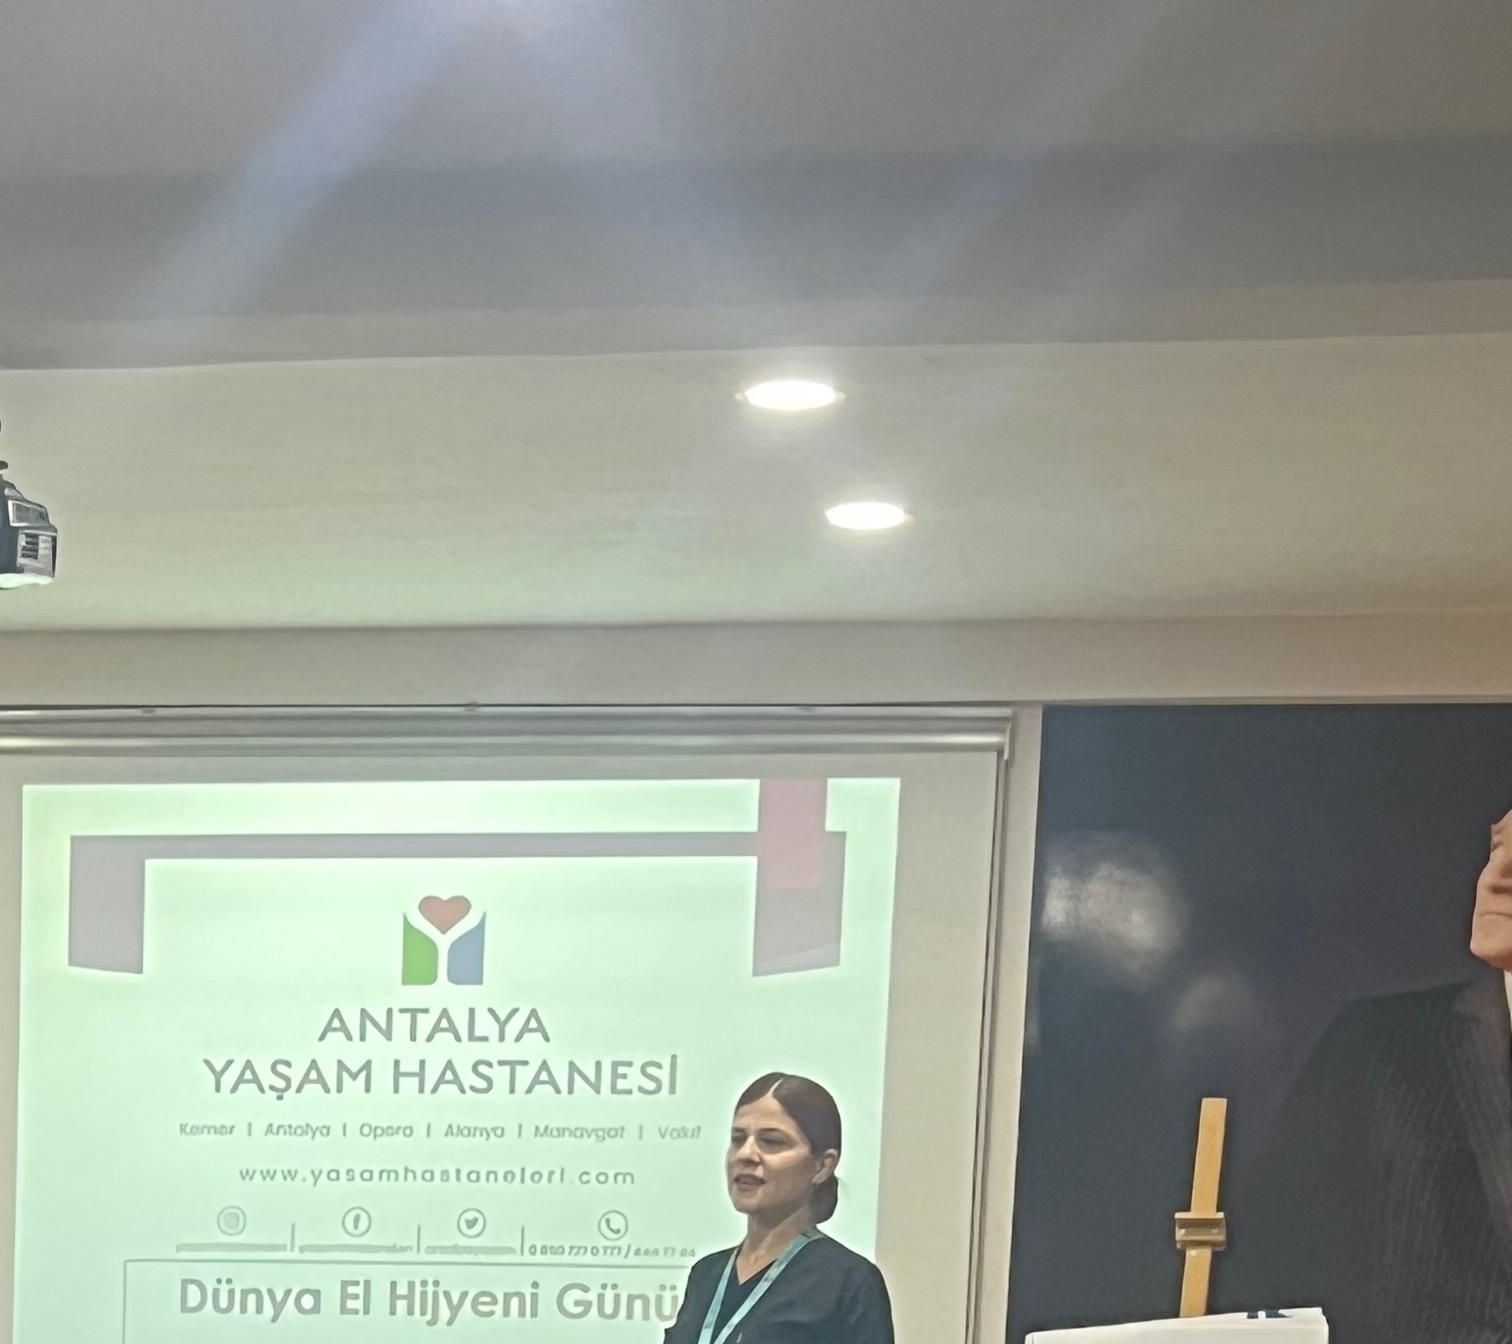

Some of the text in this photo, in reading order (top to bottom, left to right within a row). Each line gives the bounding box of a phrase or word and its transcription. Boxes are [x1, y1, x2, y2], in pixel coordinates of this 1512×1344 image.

[317, 1007, 551, 1044] ANTALYA
[202, 1053, 678, 1102] YAŞAM HASTANESİ
[264, 1122, 331, 1141] Antalya
[443, 1123, 505, 1142] Alanya
[180, 1277, 679, 1328] Dünya El Hijyeni Günü
